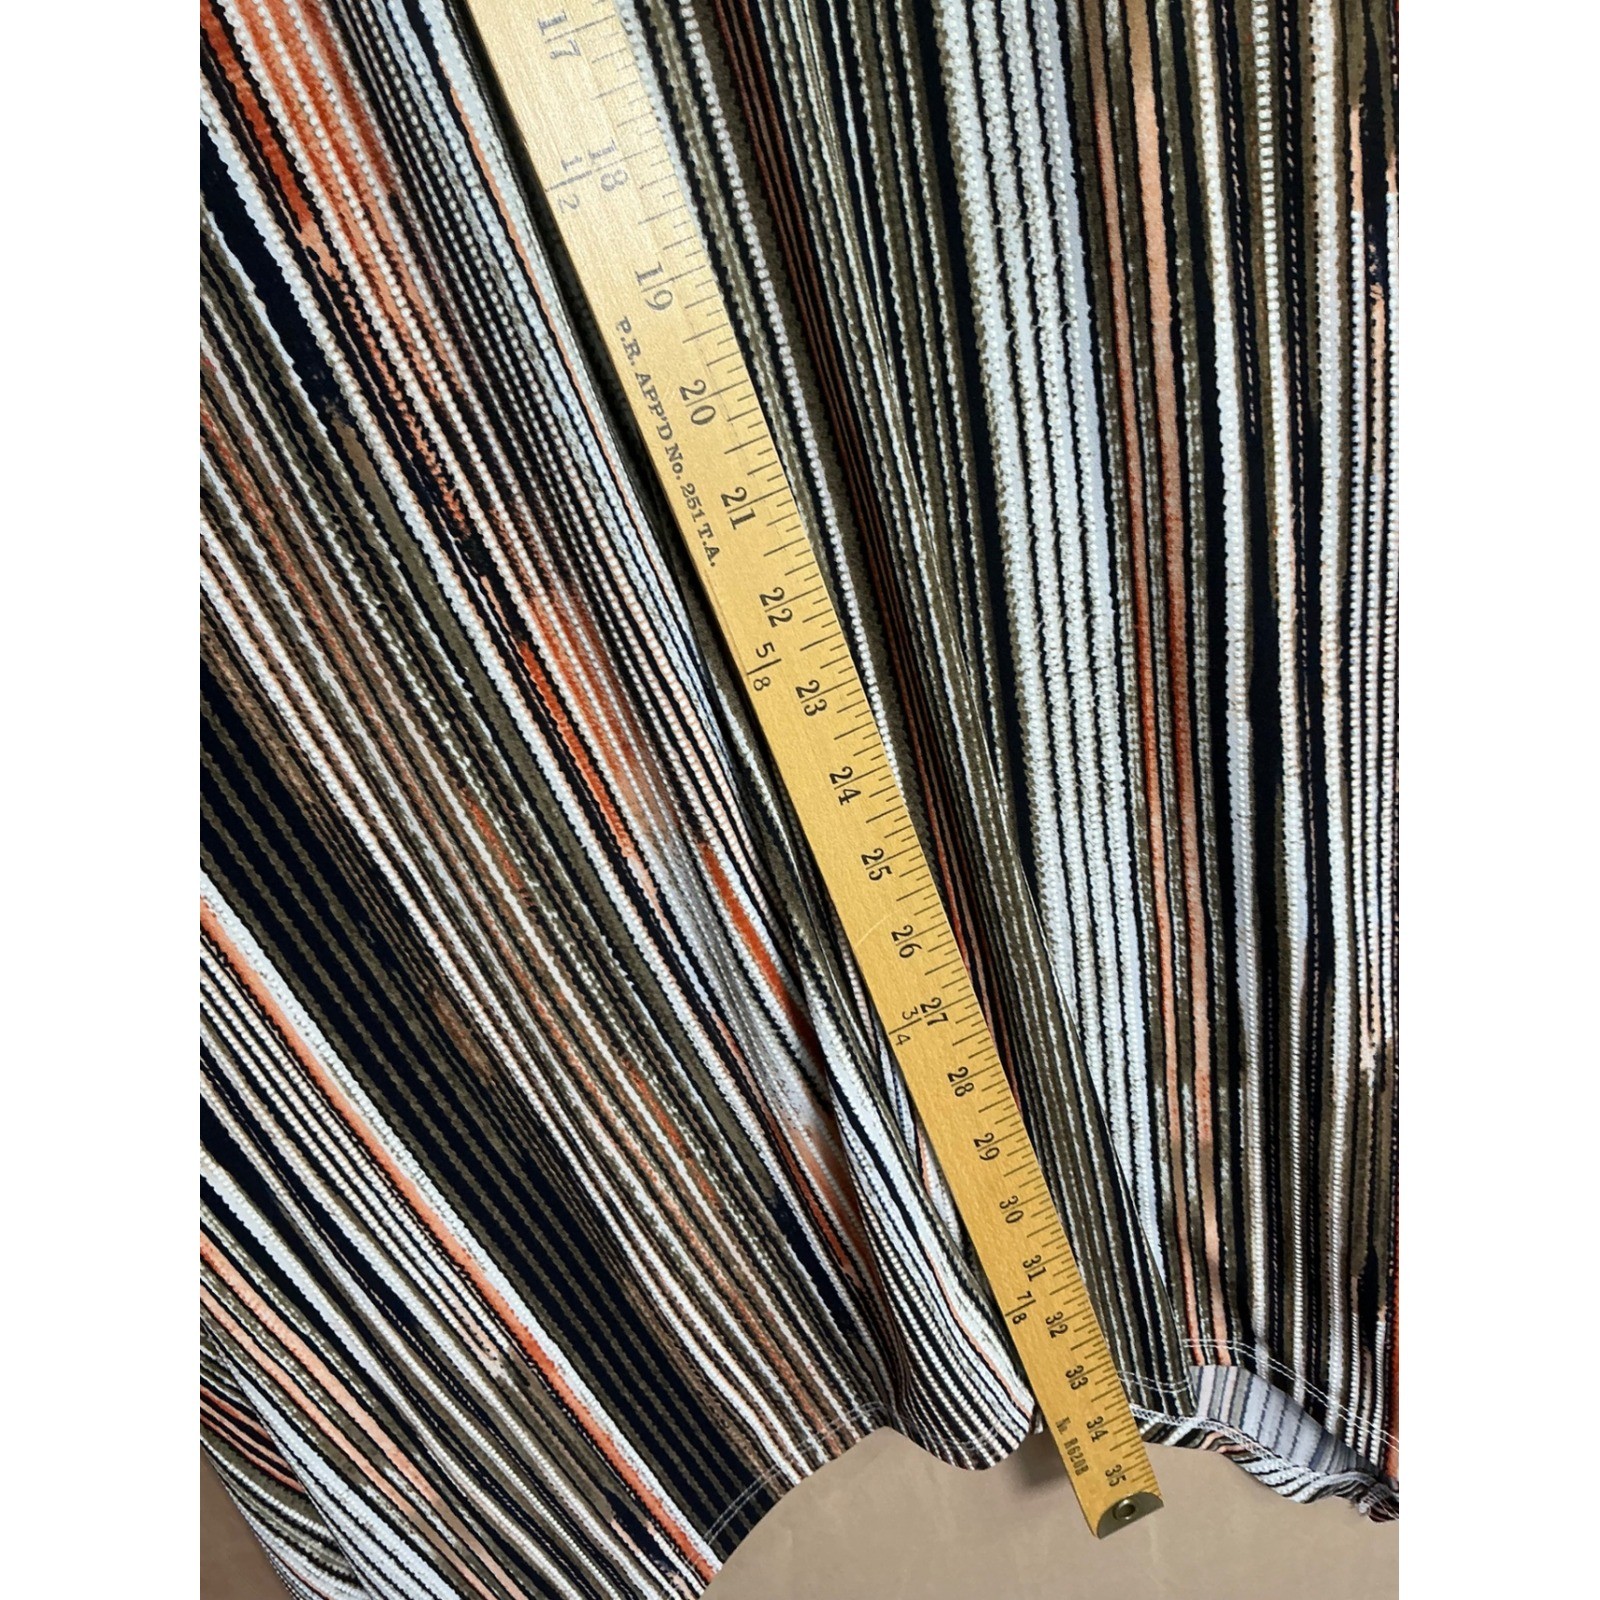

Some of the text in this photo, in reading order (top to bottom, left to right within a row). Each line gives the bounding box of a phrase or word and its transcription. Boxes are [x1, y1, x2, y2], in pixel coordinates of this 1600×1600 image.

[537, 10, 581, 60] 17
[588, 140, 628, 192] 18
[635, 262, 673, 311] 19
[679, 379, 716, 426] 20
[615, 316, 720, 567] P.R. APP'D No. 251 T.A.
[720, 486, 756, 530] 21
[759, 586, 793, 628] 22
[795, 679, 828, 717] 23
[829, 766, 862, 806] 24
[860, 847, 893, 882] 25
[891, 924, 923, 959] 26
[920, 996, 949, 1027] 27
[947, 1066, 975, 1098] 28
[973, 1132, 1000, 1162] 29
[999, 1195, 1024, 1224] 30
[1022, 1254, 1047, 1282] 31
[1045, 1311, 1068, 1339] 32
[1064, 1364, 1089, 1391] 33
[1086, 1416, 1109, 1443] 34
[1105, 1463, 1127, 1487] 35
